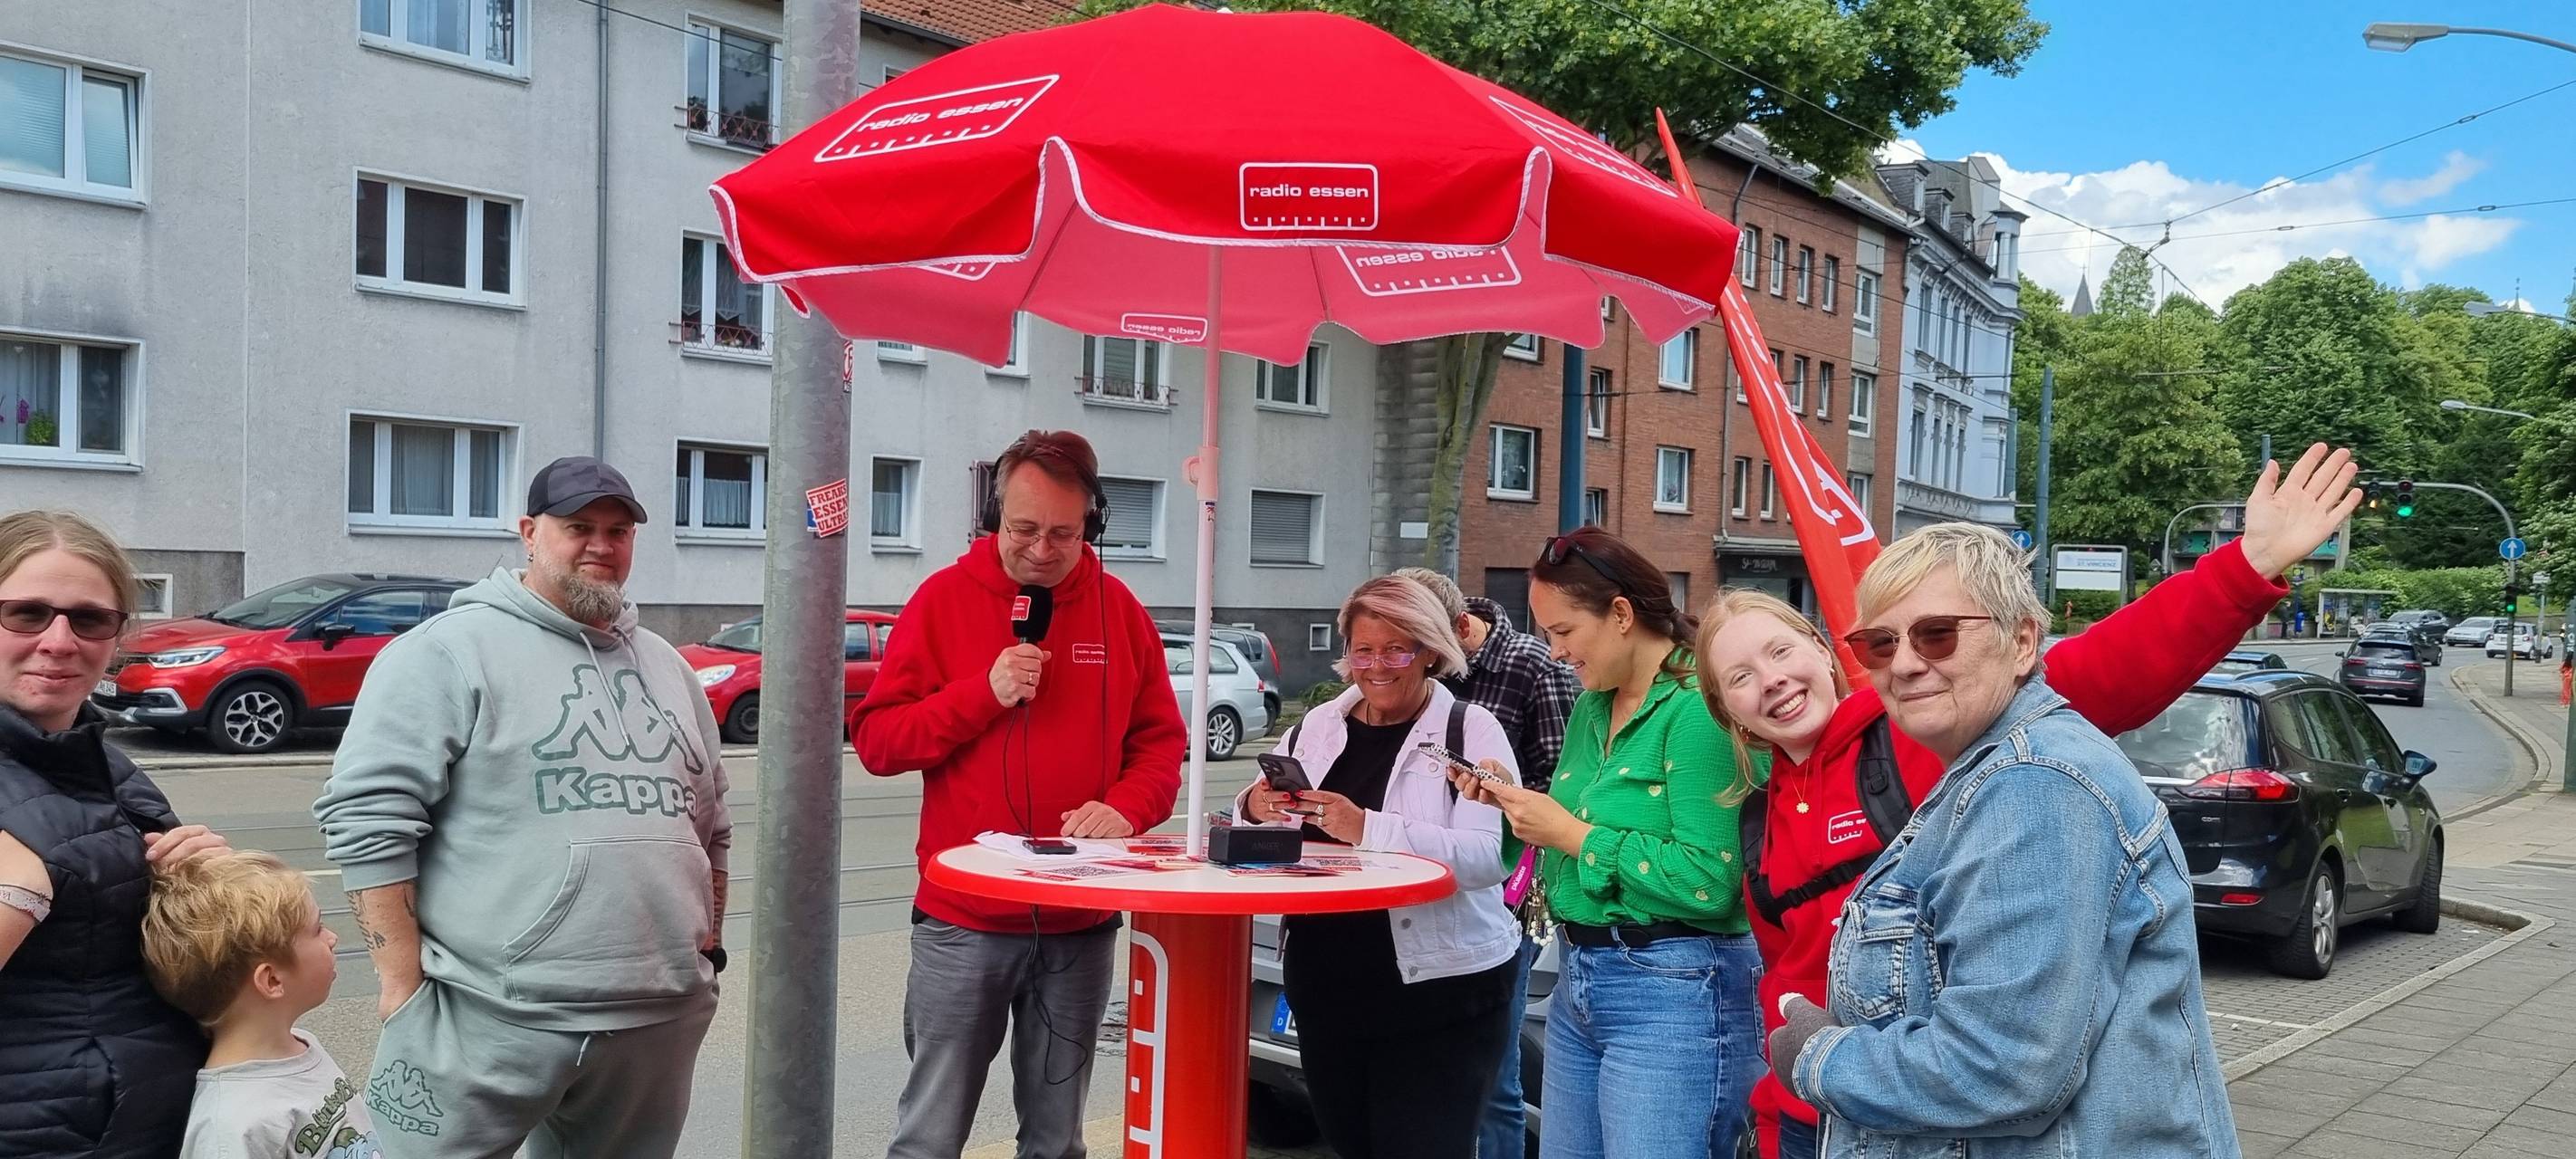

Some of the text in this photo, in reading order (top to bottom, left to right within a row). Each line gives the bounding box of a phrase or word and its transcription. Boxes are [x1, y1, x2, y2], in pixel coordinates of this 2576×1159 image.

[858, 97, 1024, 132] radio essen
[1250, 184, 1369, 197] radio essen
[809, 484, 847, 506] FREAKS
[534, 766, 697, 822] Kappa
[1277, 1017, 1283, 1026] D
[365, 1088, 439, 1136] Kappa
